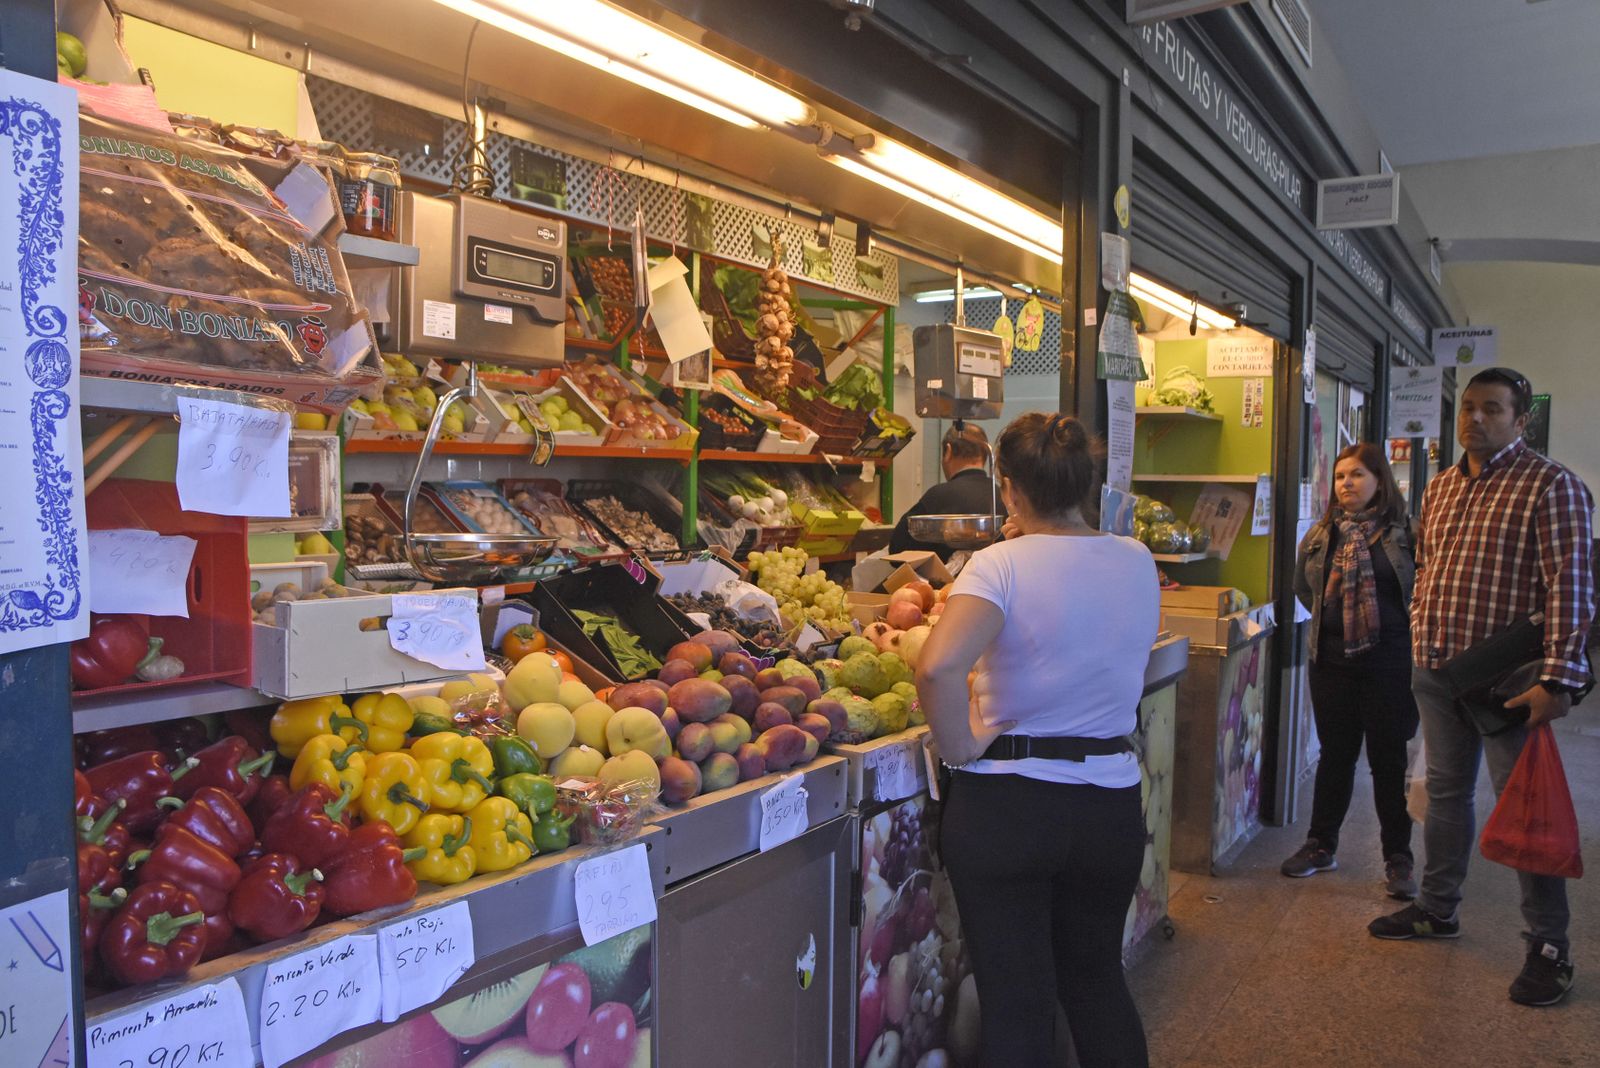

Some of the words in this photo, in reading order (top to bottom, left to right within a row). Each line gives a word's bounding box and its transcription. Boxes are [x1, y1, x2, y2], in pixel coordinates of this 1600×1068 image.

[1155, 20, 1211, 111] FRUTAS
[1213, 81, 1223, 121] Y
[1224, 93, 1302, 208] VERDURAS-PILAR
[100, 286, 174, 332] DON
[177, 308, 294, 343] BONIATO
[1439, 329, 1493, 339] ACEITUNAS
[211, 383, 286, 395] ASADOS
[320, 943, 355, 967] Verde
[266, 989, 329, 1027] 2.20
[91, 1011, 155, 1049] Pimiento
